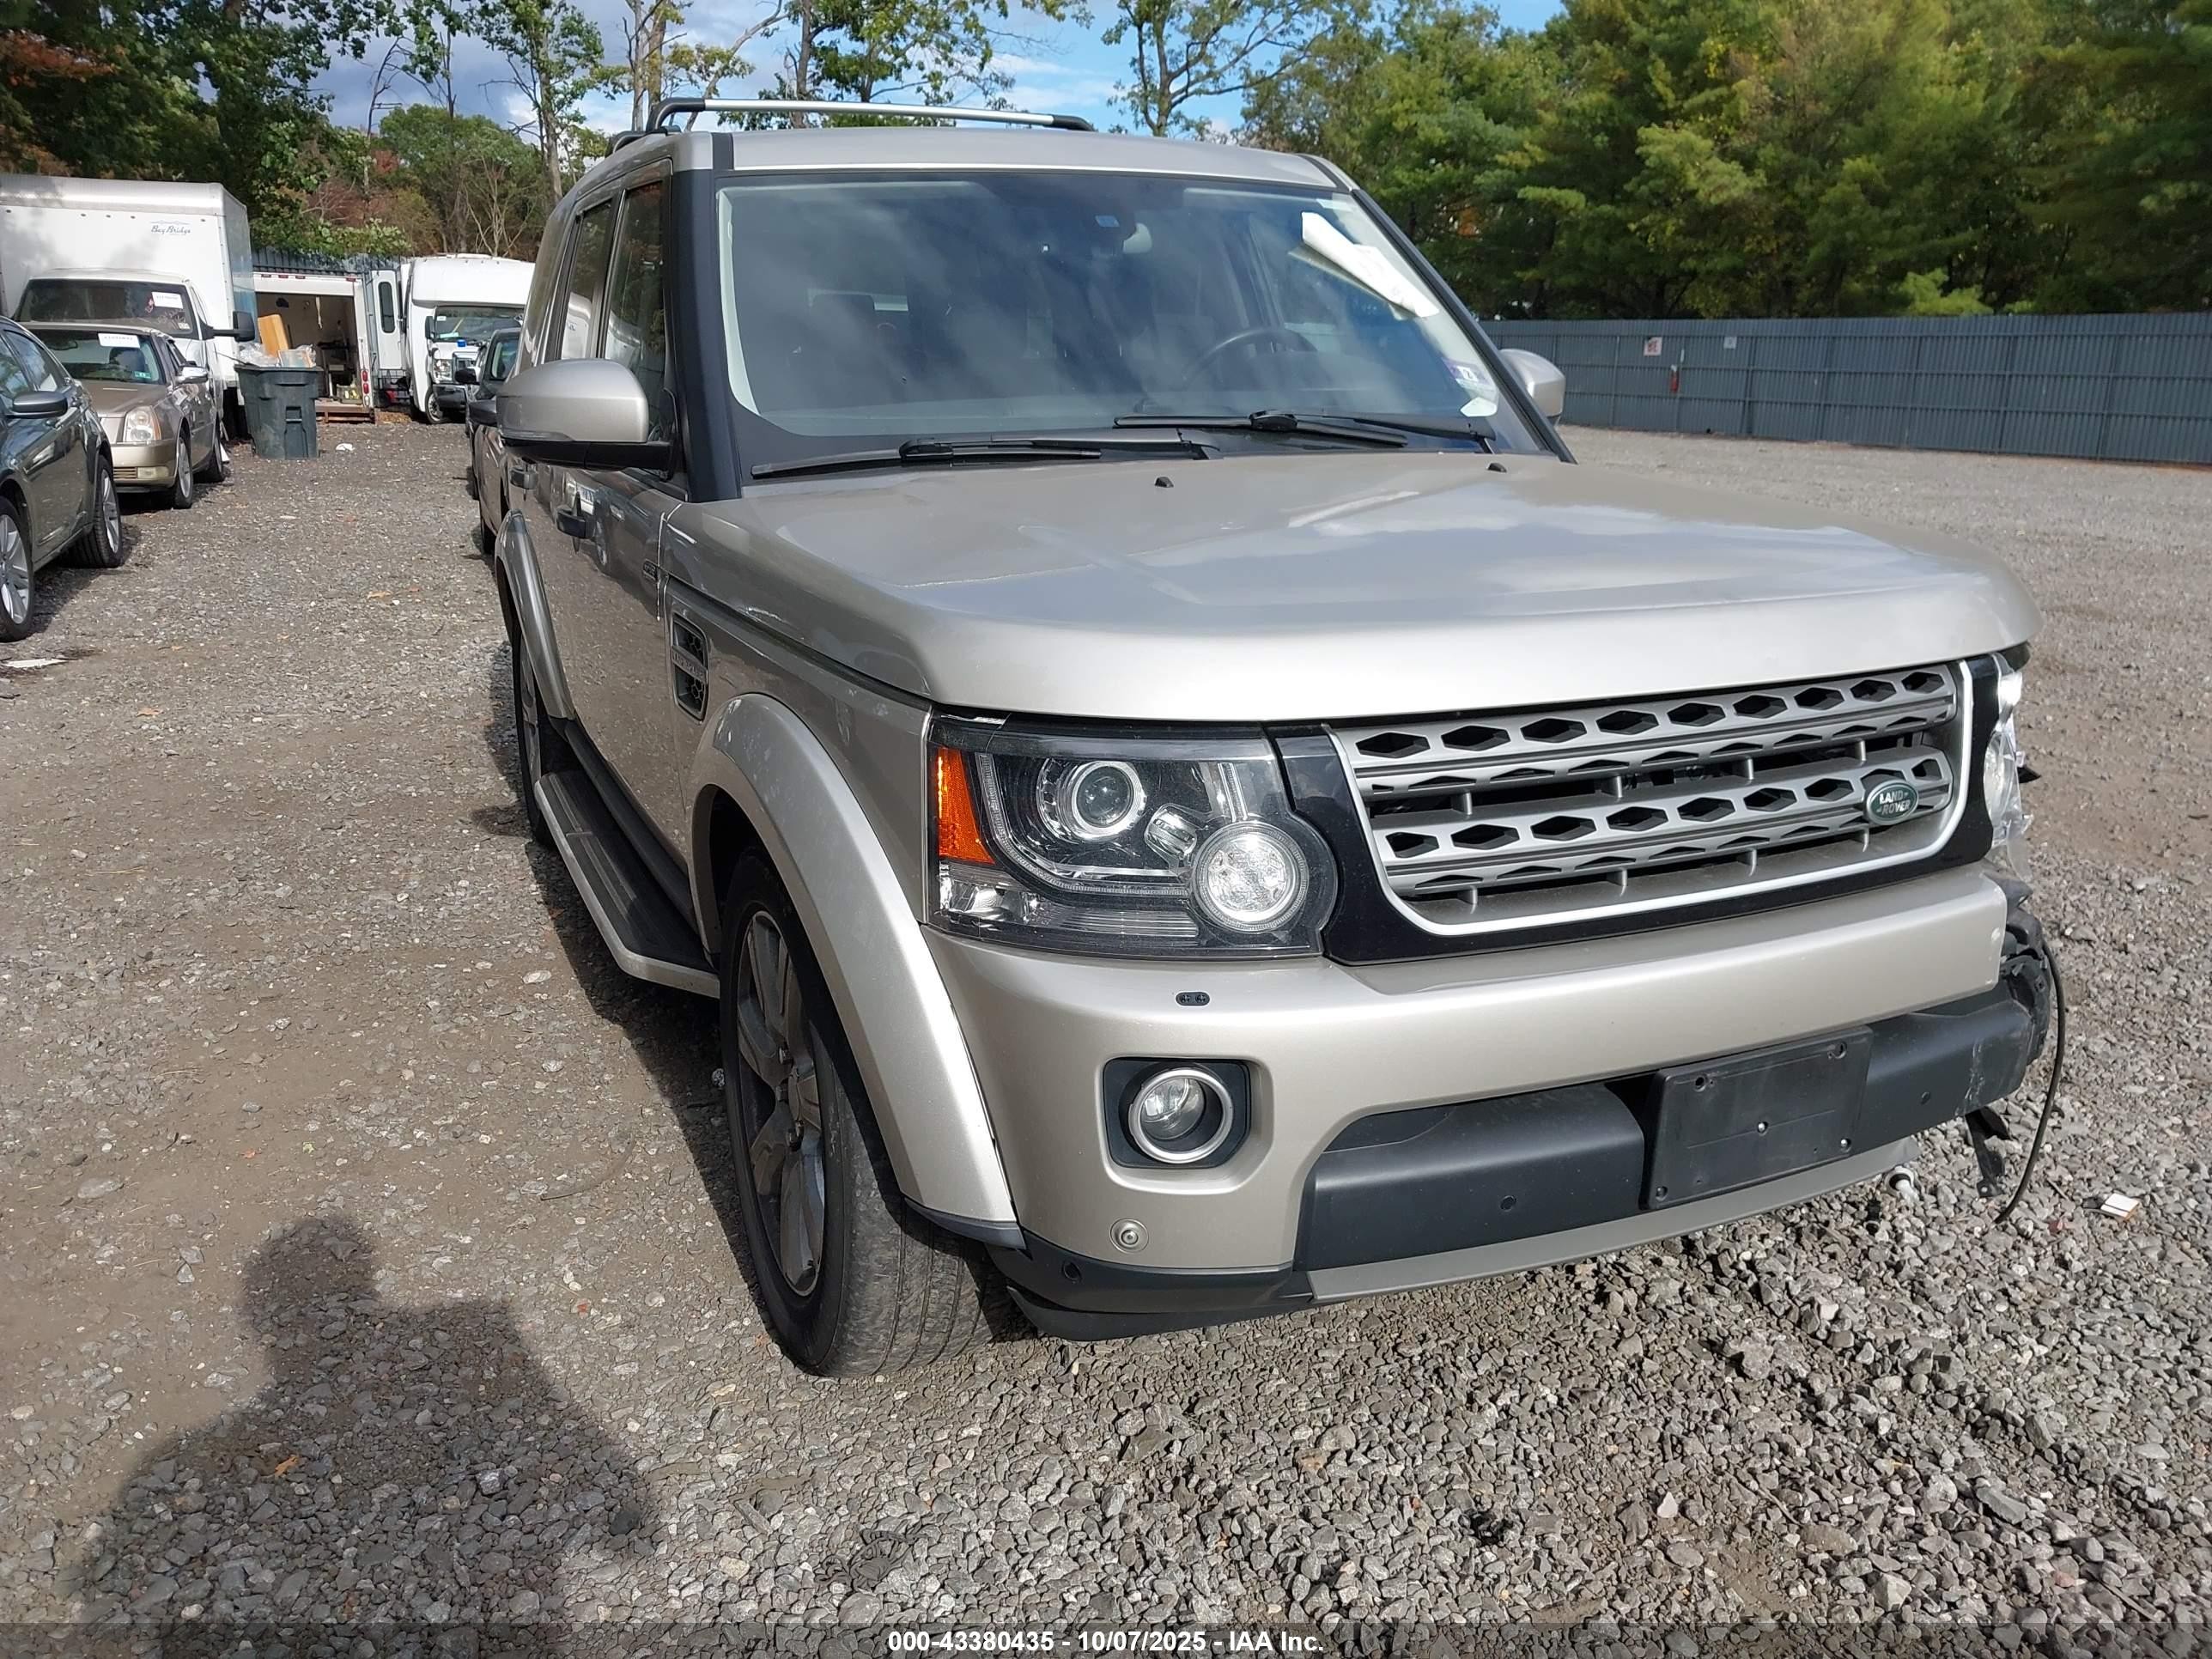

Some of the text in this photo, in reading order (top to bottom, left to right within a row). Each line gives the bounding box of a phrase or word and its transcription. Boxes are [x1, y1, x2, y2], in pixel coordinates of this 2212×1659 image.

[151, 224, 191, 235] Bay Bridge
[1879, 790, 1904, 805] LAND
[1881, 799, 1911, 815] ROVER
